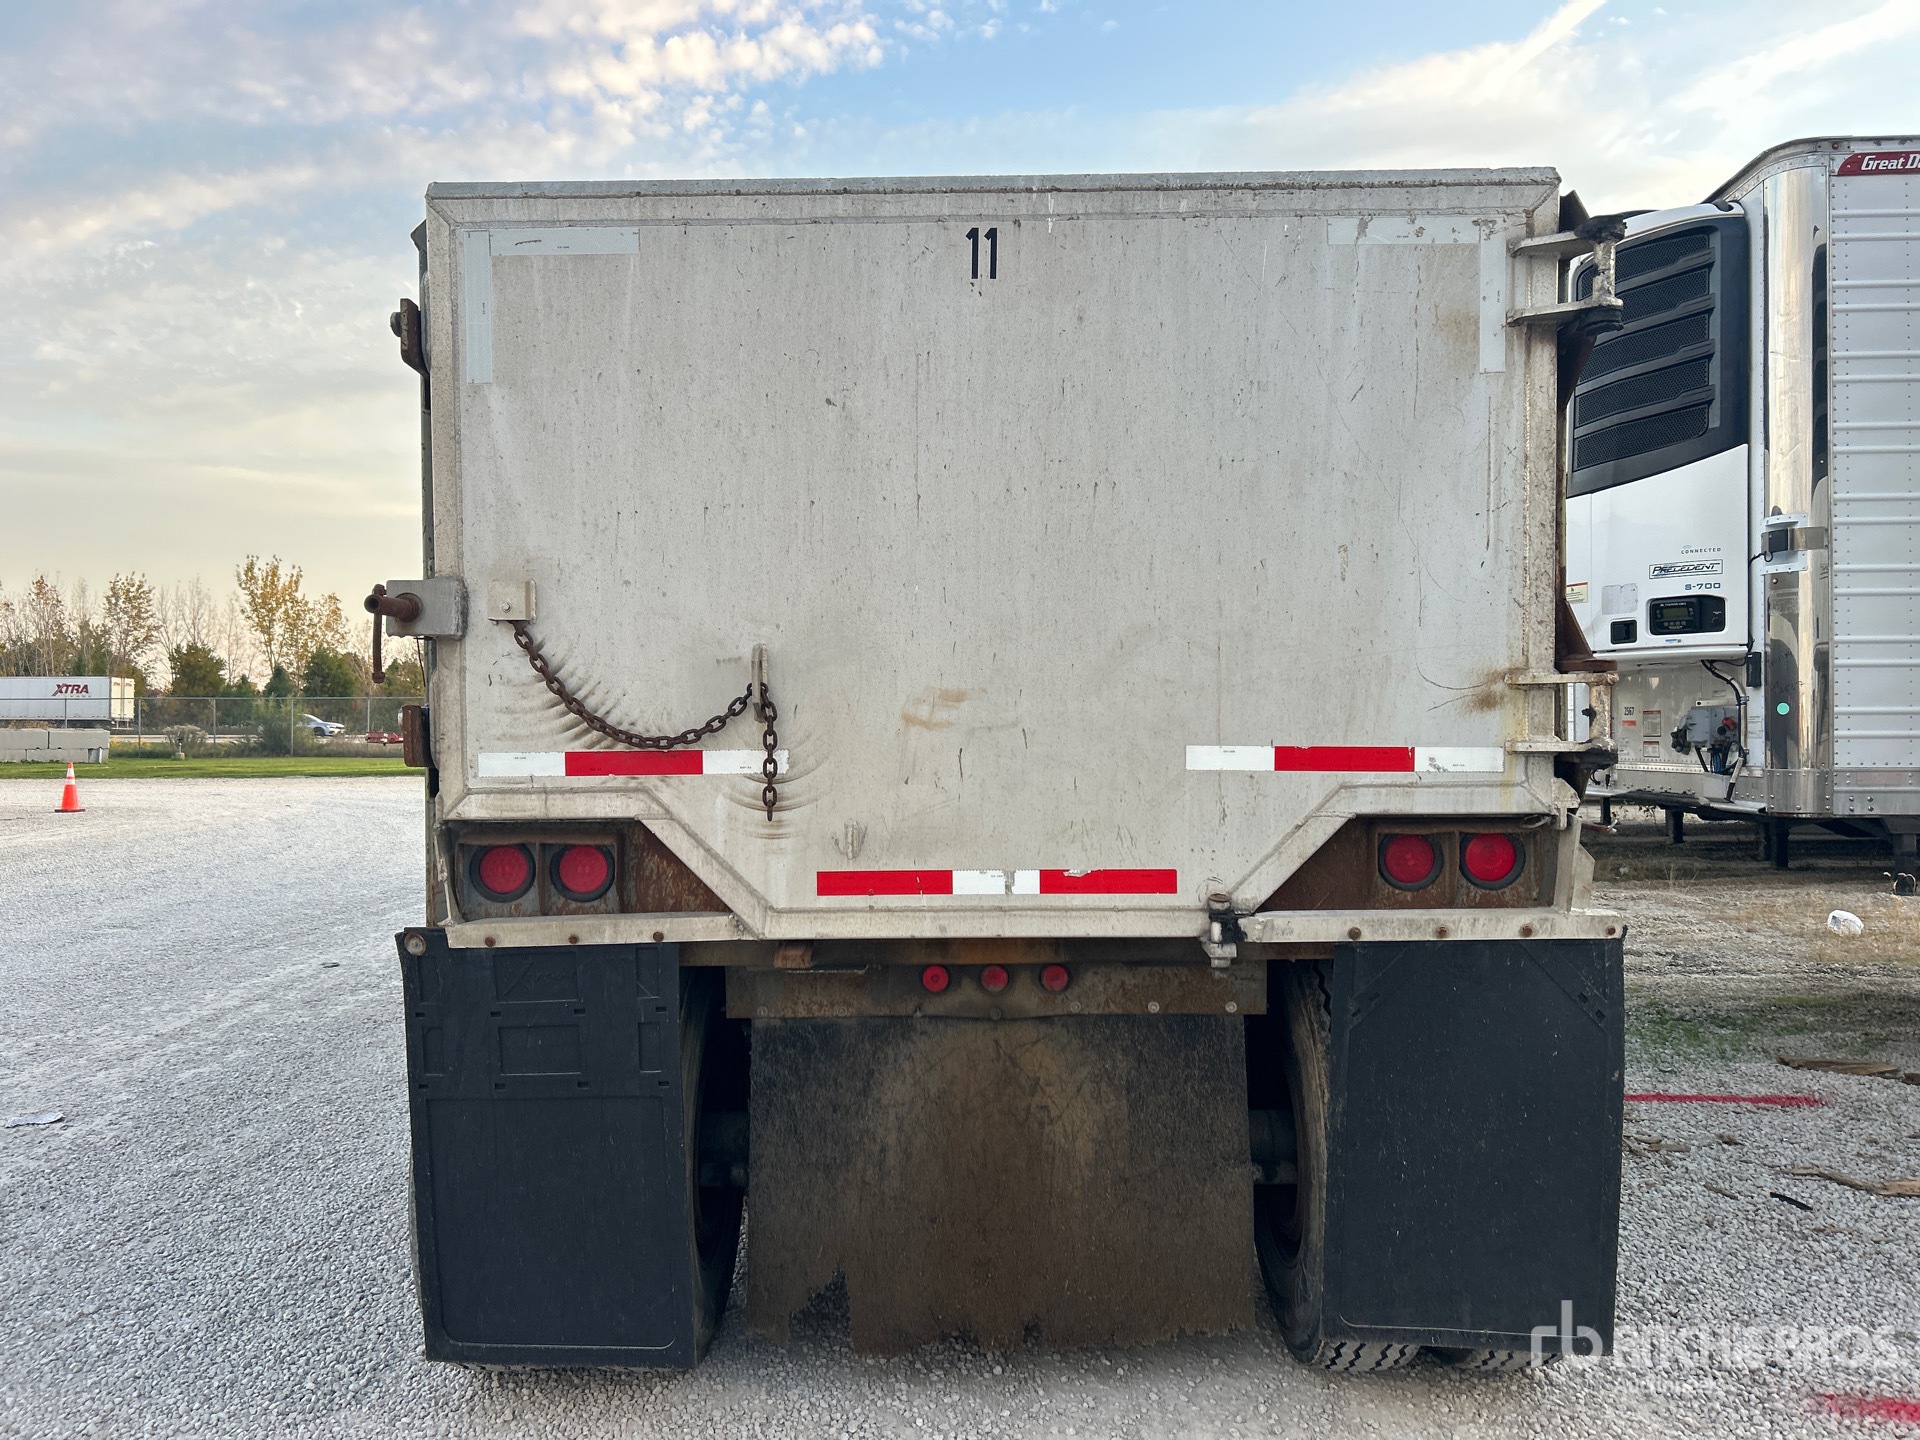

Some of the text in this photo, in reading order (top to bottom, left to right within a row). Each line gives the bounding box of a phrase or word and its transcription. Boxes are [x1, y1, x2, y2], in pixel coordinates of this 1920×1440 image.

[1861, 153, 1920, 170] Great D
[965, 227, 998, 279] 11
[1681, 547, 1722, 555] CONNECTED
[1652, 562, 1721, 575] PRECEDENT
[1684, 582, 1721, 590] S-700
[51, 683, 90, 697] XTRA
